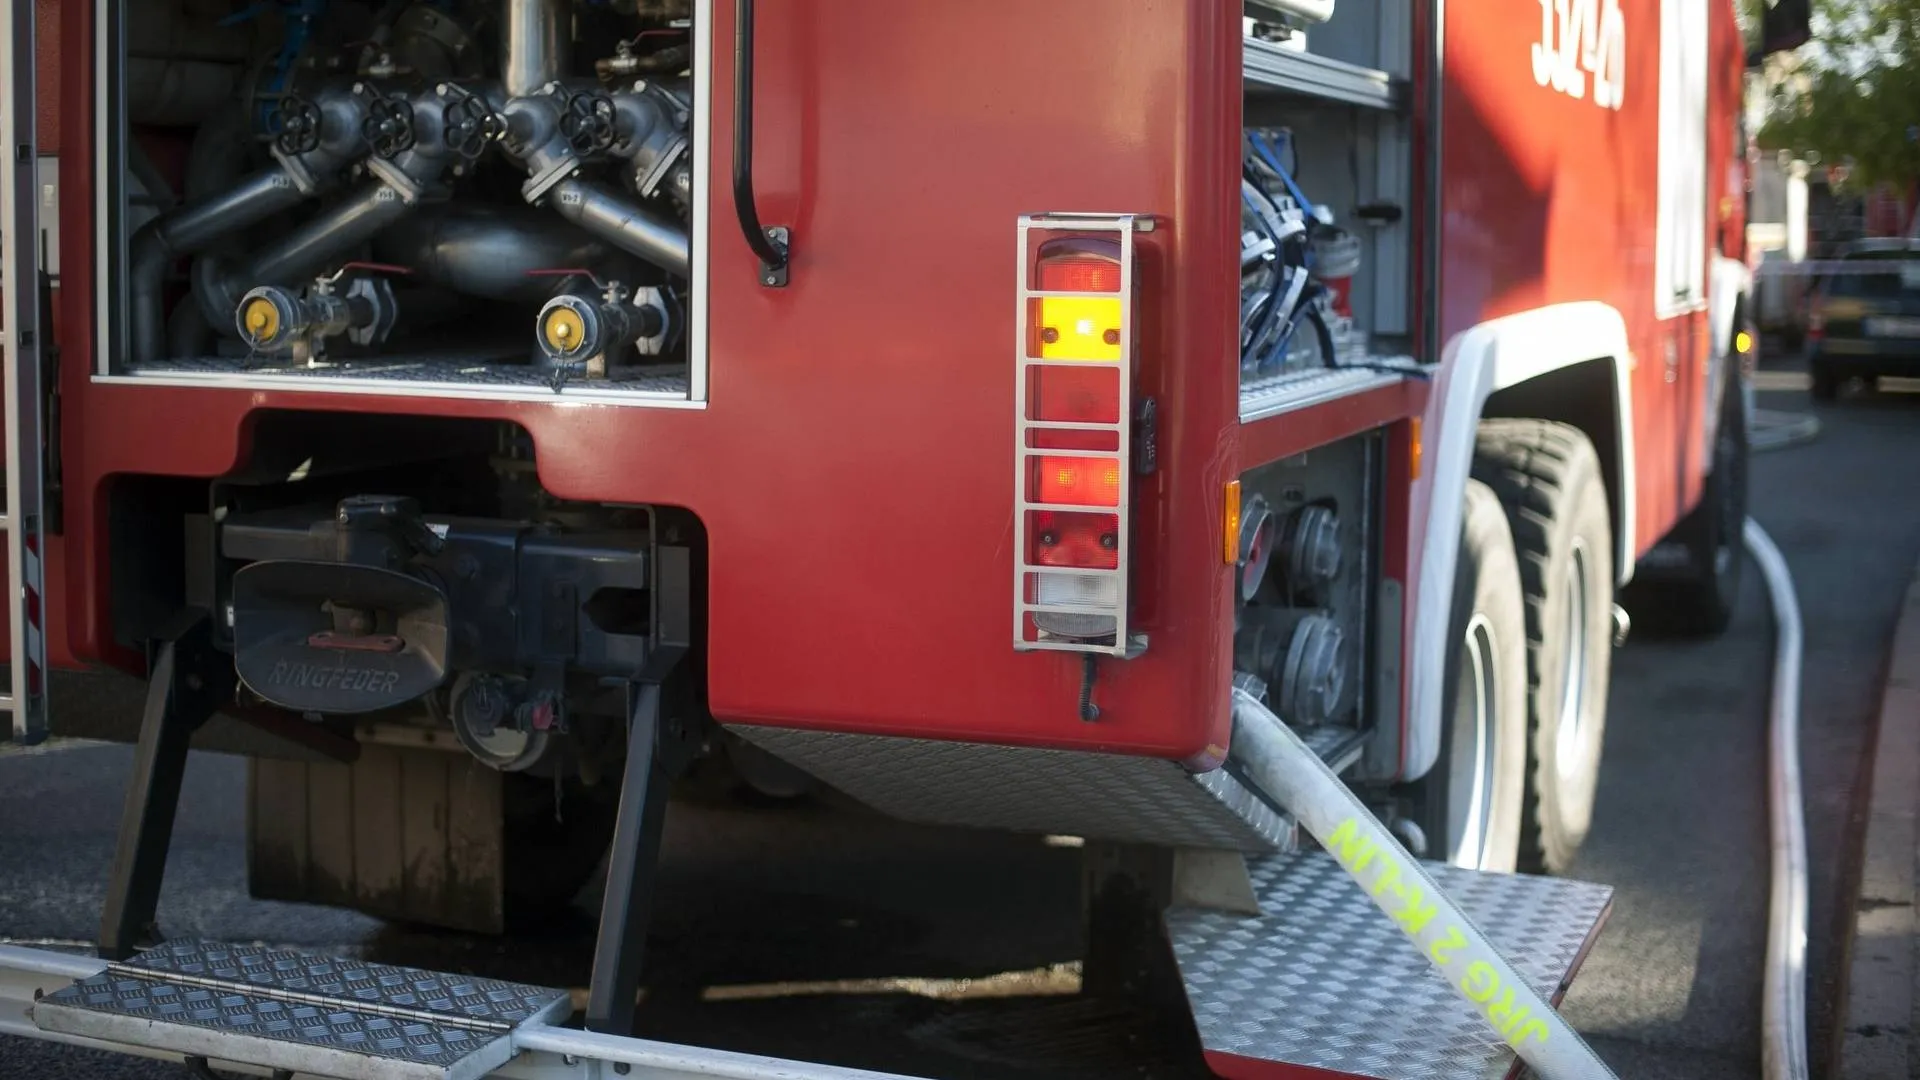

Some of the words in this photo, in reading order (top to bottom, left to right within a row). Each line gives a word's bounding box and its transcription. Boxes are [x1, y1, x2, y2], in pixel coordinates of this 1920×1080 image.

[268, 656, 399, 693] RINGFEDER
[1430, 925, 1469, 965] 2
[1461, 960, 1548, 1046] JRG
